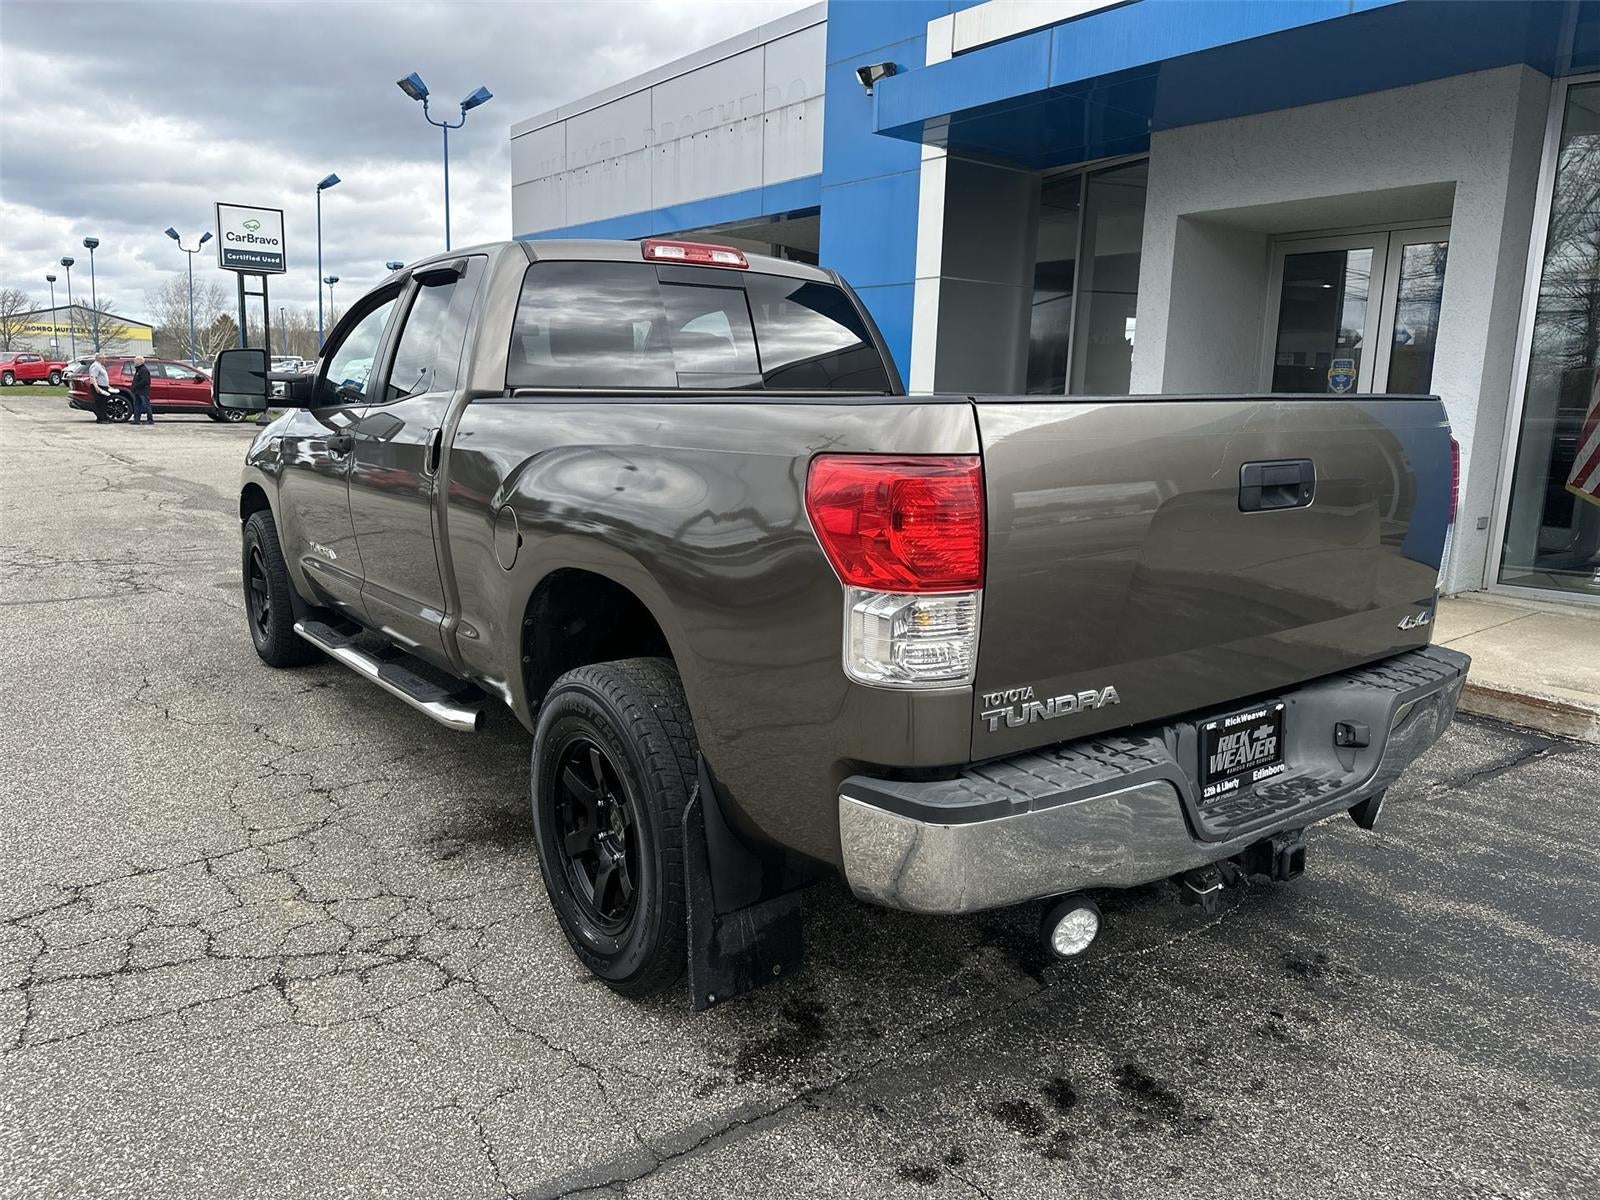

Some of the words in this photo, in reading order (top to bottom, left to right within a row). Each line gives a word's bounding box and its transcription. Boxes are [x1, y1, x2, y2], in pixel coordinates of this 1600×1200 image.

[226, 231, 278, 246] CarBravo
[227, 253, 260, 262] Certified
[982, 686, 1035, 708] TOYOTA
[980, 685, 1120, 732] TUNDRA
[1225, 710, 1267, 727] RickWeaver
[1218, 729, 1250, 753] RICK
[1210, 737, 1277, 774] WEAVER
[1253, 764, 1284, 780] Edinboro
